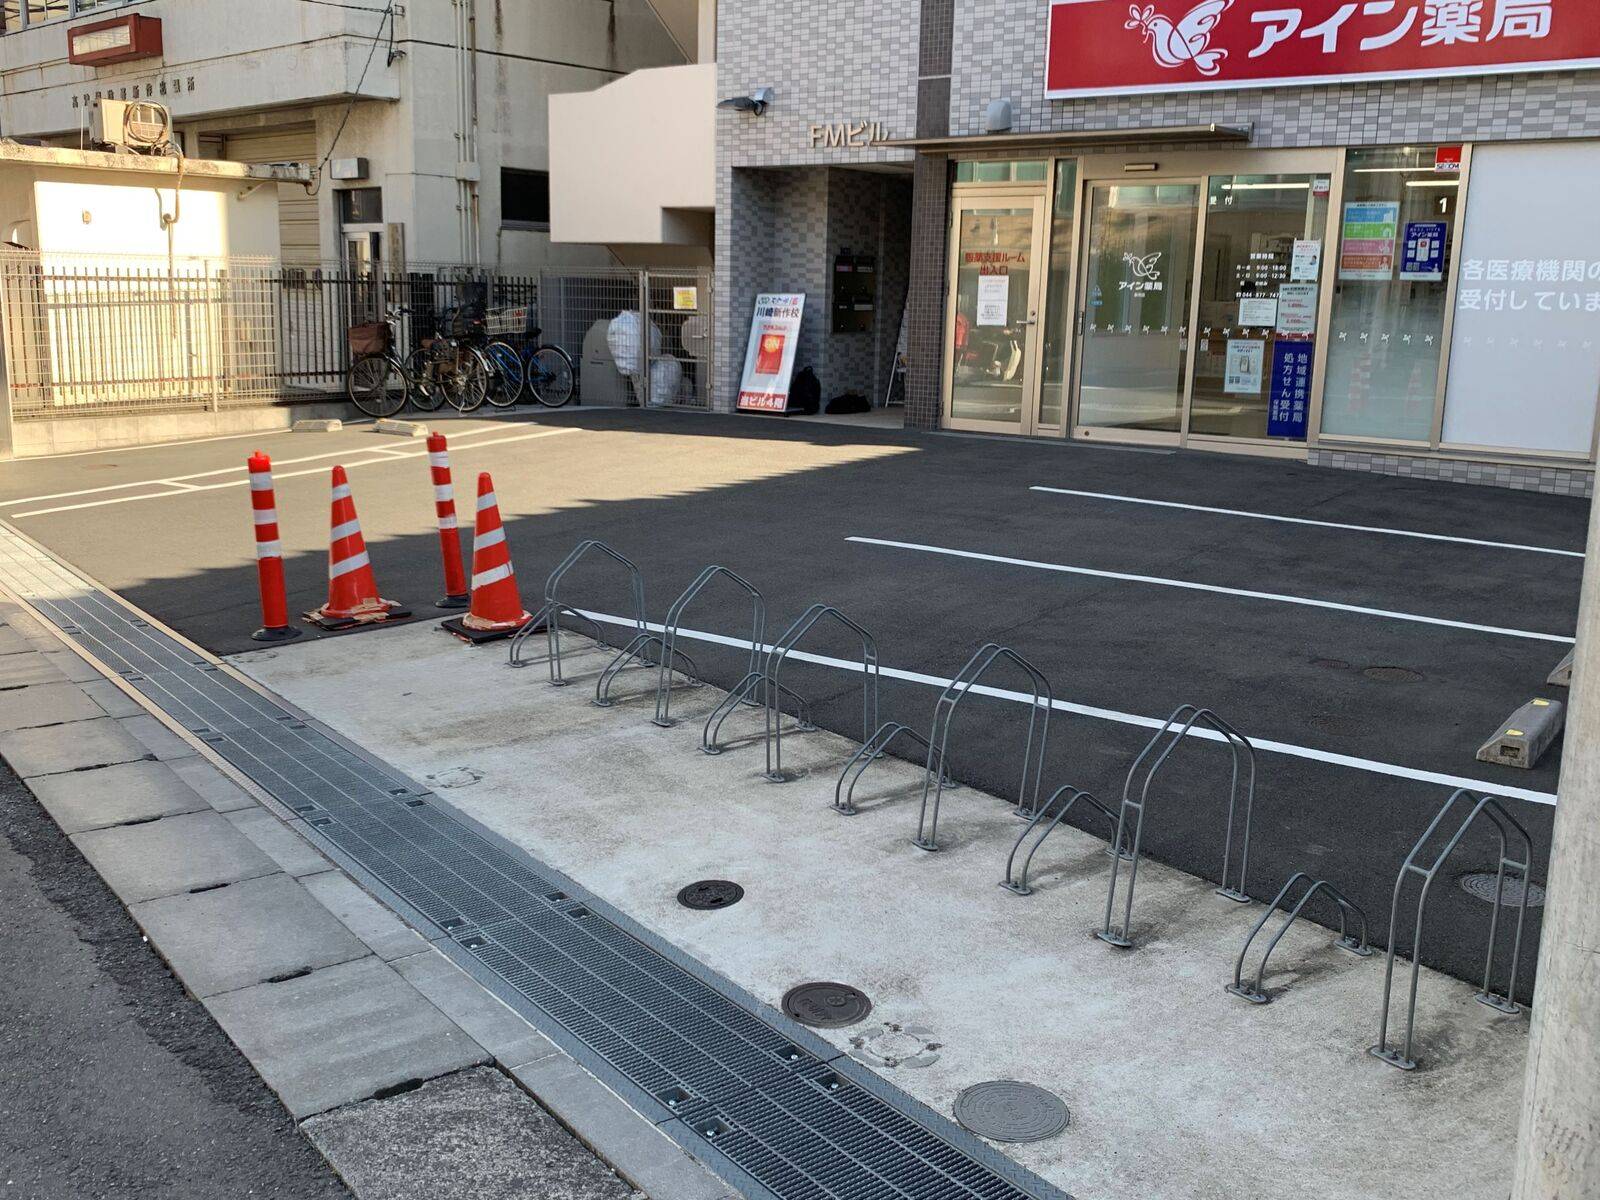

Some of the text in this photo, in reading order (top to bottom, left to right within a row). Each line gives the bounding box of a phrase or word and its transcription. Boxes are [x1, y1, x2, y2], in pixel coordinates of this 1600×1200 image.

[1248, 0, 1553, 58] アイン薬局
[810, 120, 889, 148] FMビル
[1439, 197, 1448, 213] 1
[980, 265, 1008, 275] 出入口
[1118, 281, 1163, 291] アイン薬局
[1458, 289, 1600, 312] 受付していま
[1279, 353, 1294, 422] 処方せん受付
[1292, 353, 1308, 423] 地域連携薬局
